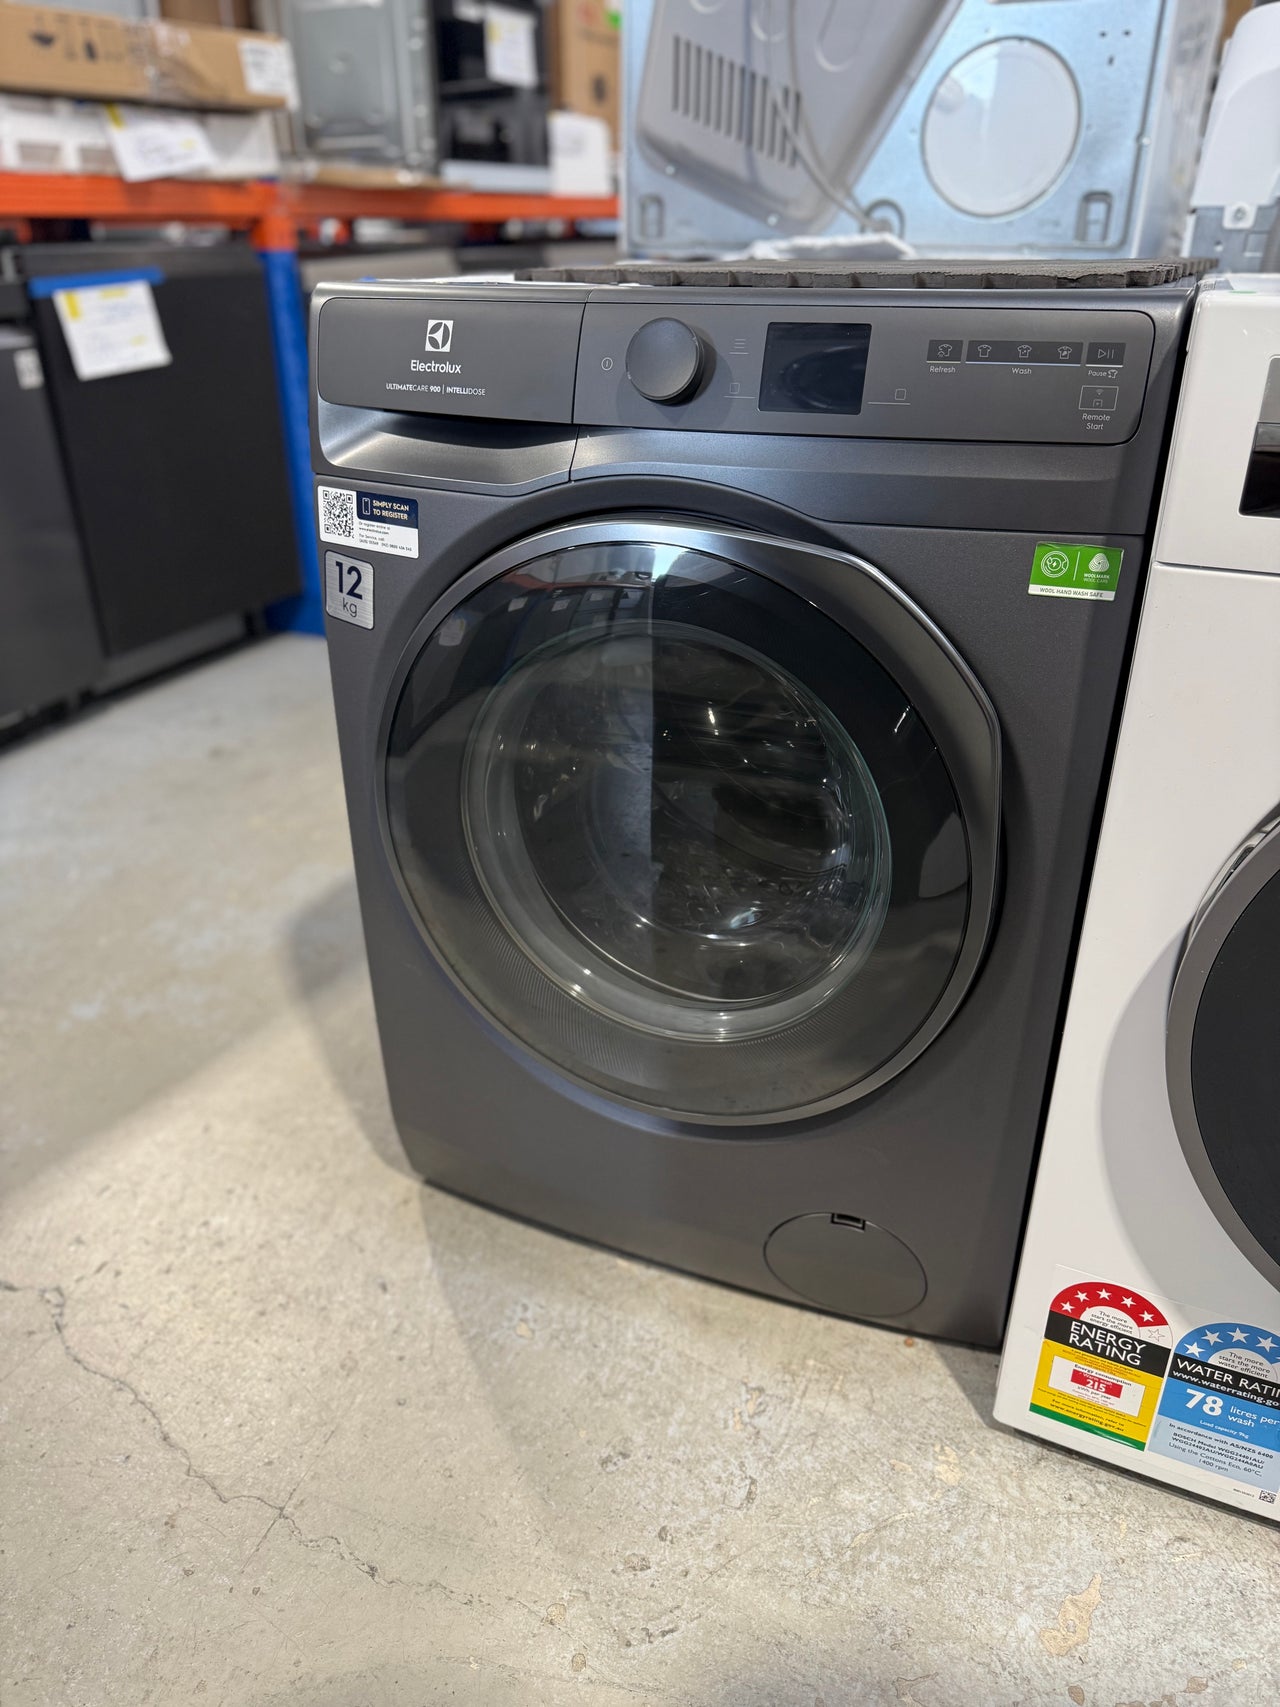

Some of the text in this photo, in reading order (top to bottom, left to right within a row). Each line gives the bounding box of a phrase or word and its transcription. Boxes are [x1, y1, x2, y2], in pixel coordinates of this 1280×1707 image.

[410, 359, 462, 374] Electrolux
[929, 365, 956, 374] Refresh
[1012, 367, 1032, 375] Wash
[1088, 369, 1108, 377] Pause
[386, 382, 486, 396] ULTIMATECARE 900 INTELLIDOSE
[1082, 412, 1111, 422] Remote
[1086, 421, 1104, 431] Start
[372, 499, 409, 512] SIMPLY SCAN
[373, 508, 408, 521] TO REGISTER
[335, 560, 363, 600] 12
[1083, 572, 1110, 580] WOOLMARK
[342, 597, 358, 618] kg
[1091, 1313, 1105, 1321] stars
[1117, 1322, 1133, 1330] more
[1099, 1310, 1110, 1318] The
[1090, 1318, 1109, 1328] energy
[1070, 1320, 1147, 1355] ENERGY
[1069, 1332, 1142, 1366] RATING
[1219, 1355, 1235, 1364] stars
[1250, 1364, 1271, 1374] more
[1229, 1351, 1264, 1366] The more
[1074, 1363, 1095, 1375] Energy
[1094, 1371, 1132, 1387] consumption
[1177, 1358, 1234, 1385] WATER
[1218, 1360, 1269, 1379] water efficient
[1085, 1378, 1107, 1392] 215
[1185, 1388, 1280, 1426] 78 litres per
[1200, 1419, 1214, 1428] Load
[1214, 1424, 1238, 1436] capacity
[1227, 1414, 1255, 1428] wash
[1173, 1432, 1197, 1443] BOSCH
[1197, 1439, 1217, 1450] Model
[1176, 1425, 1213, 1440] accordance
[1214, 1437, 1228, 1445] with
[1229, 1442, 1256, 1454] AS/NZS
[1257, 1451, 1274, 1459] 6400
[1168, 1441, 1186, 1453] Using
[1187, 1448, 1199, 1456] the
[1199, 1452, 1226, 1465] Cottons
[1198, 1458, 1229, 1473] 1400 rpm
